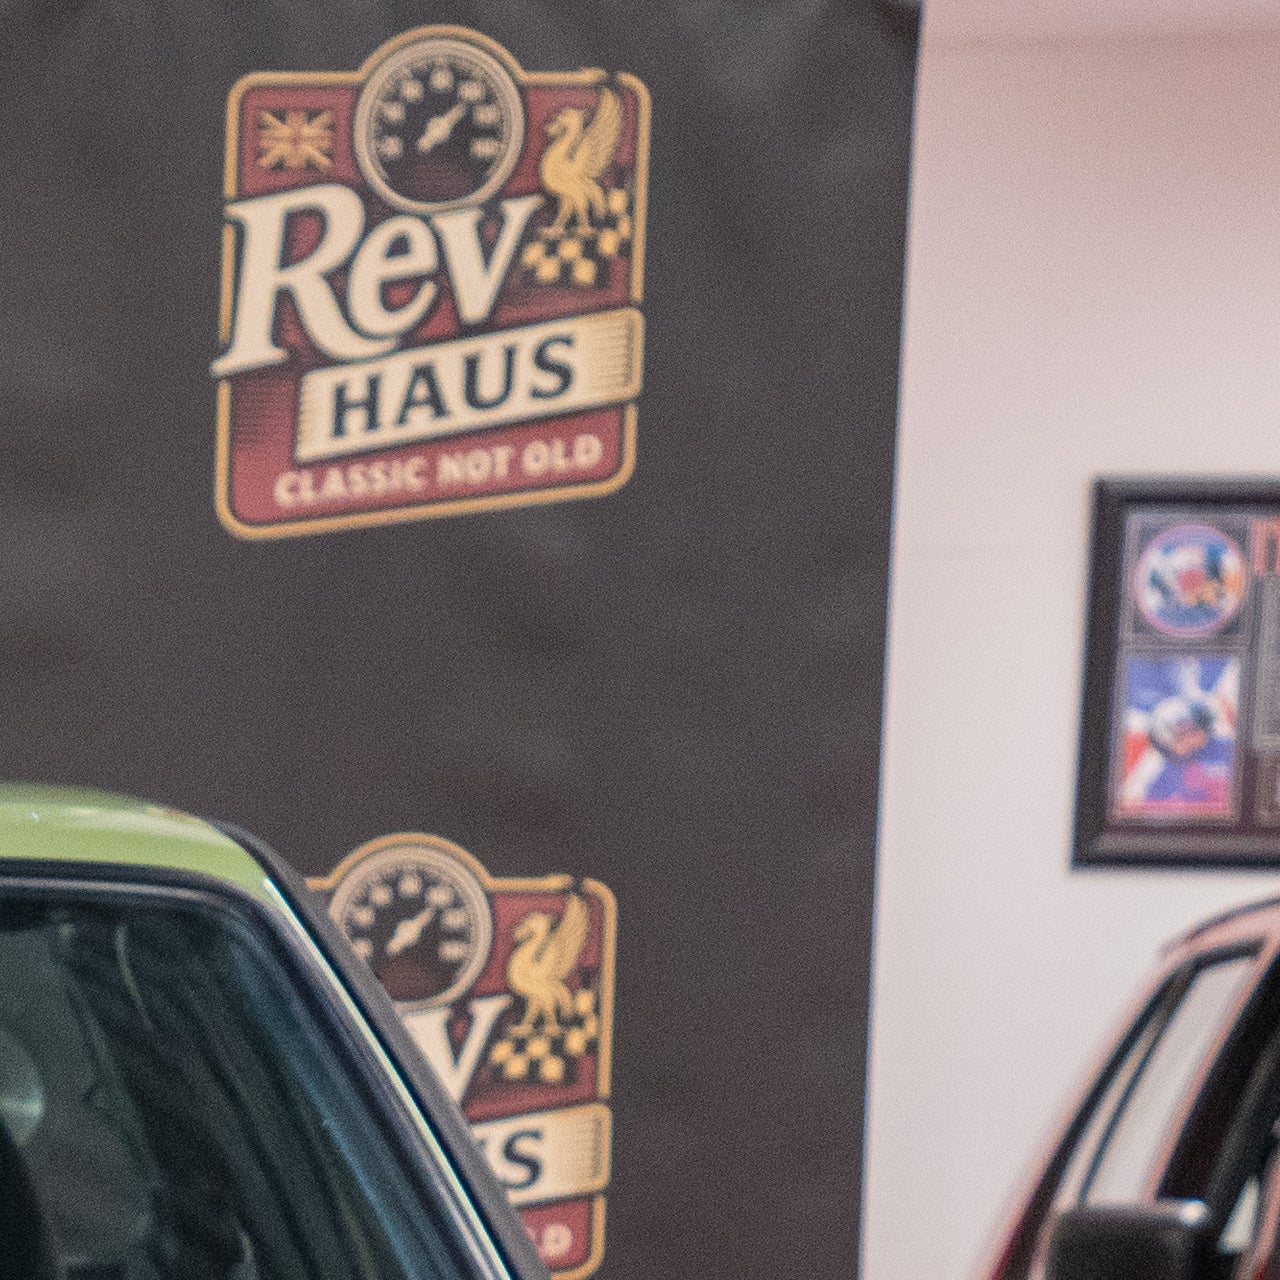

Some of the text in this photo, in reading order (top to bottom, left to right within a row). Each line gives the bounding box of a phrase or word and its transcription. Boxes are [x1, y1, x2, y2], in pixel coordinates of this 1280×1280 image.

[332, 333, 575, 438] HAUS
[273, 432, 604, 508] CLASSIC NOT OLD
